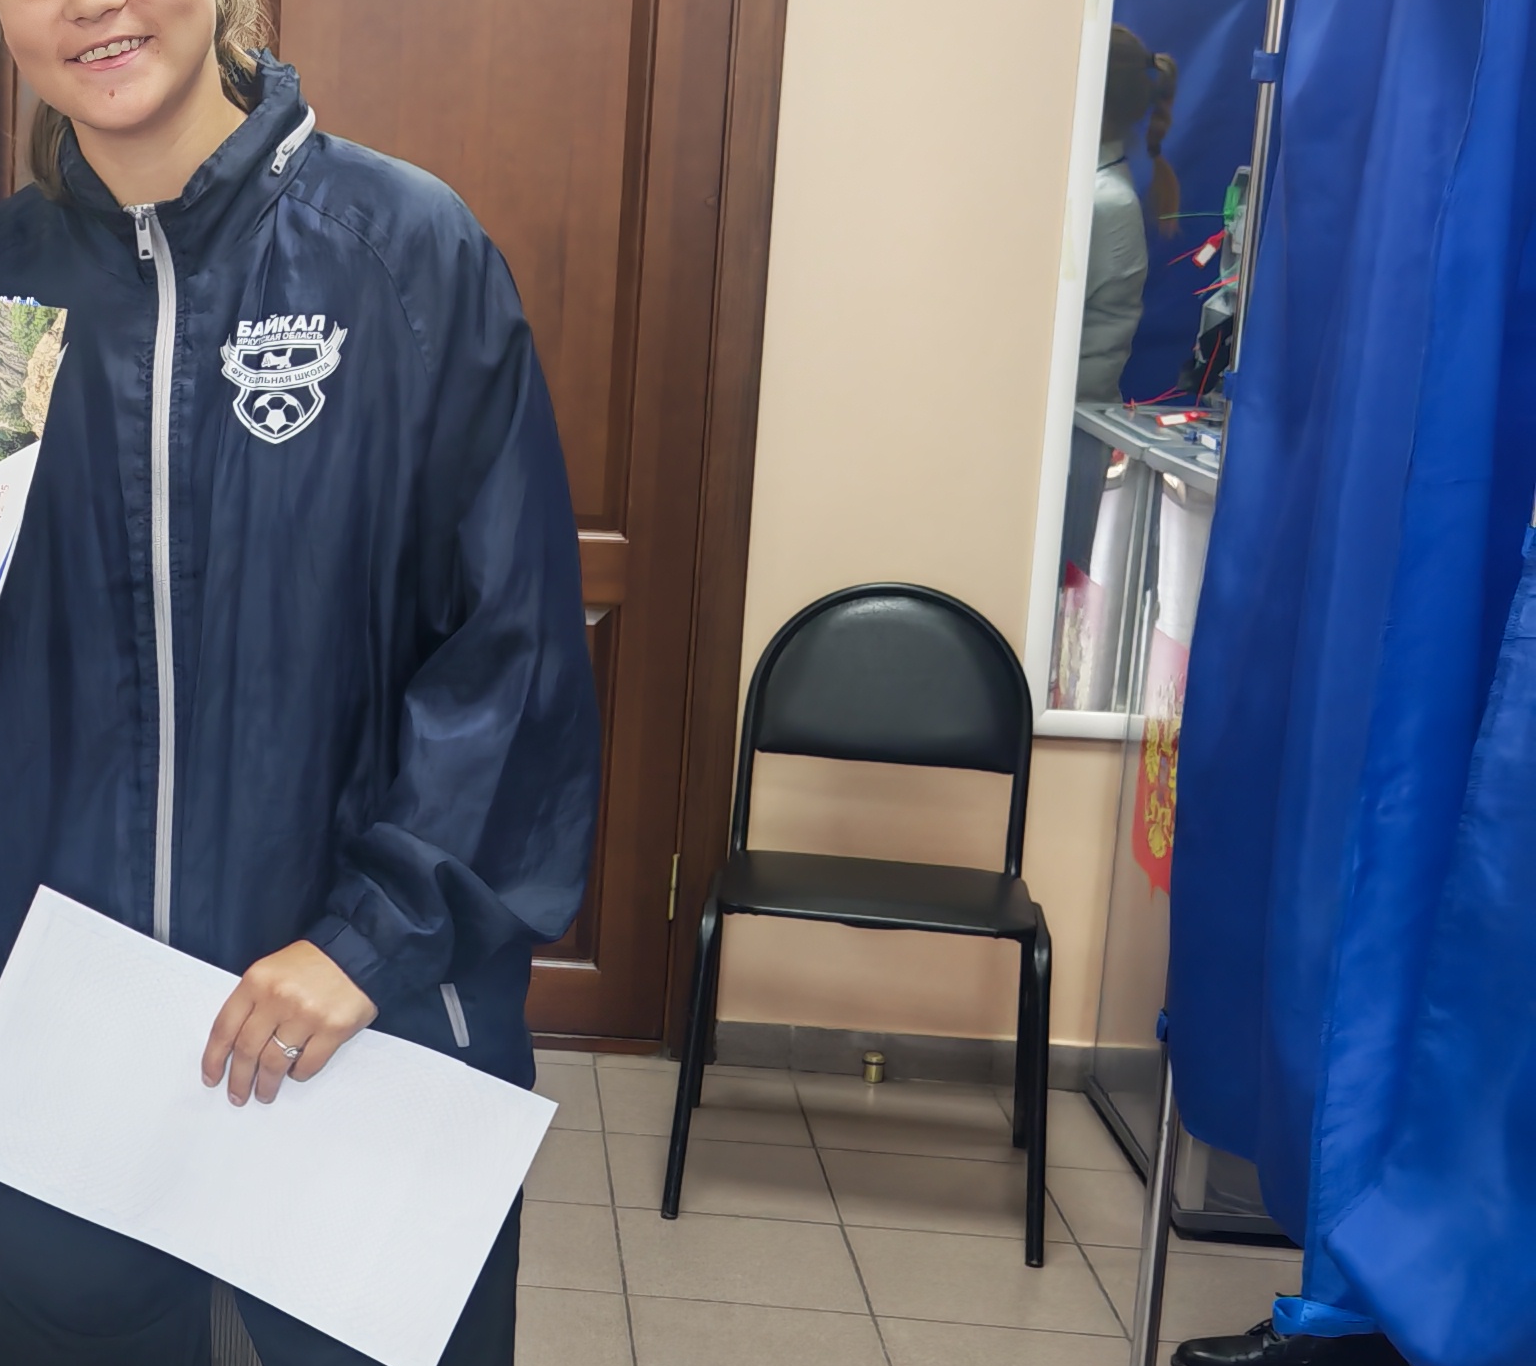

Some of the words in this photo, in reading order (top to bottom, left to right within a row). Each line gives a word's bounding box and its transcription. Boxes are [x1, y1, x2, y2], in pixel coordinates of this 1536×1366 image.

[236, 314, 326, 338] БАЙКАЛ
[282, 331, 324, 340] ОБЛАСТЬ
[231, 367, 292, 384] ФУТБЛЬНАЯ
[294, 362, 331, 381] ШКОЛА
